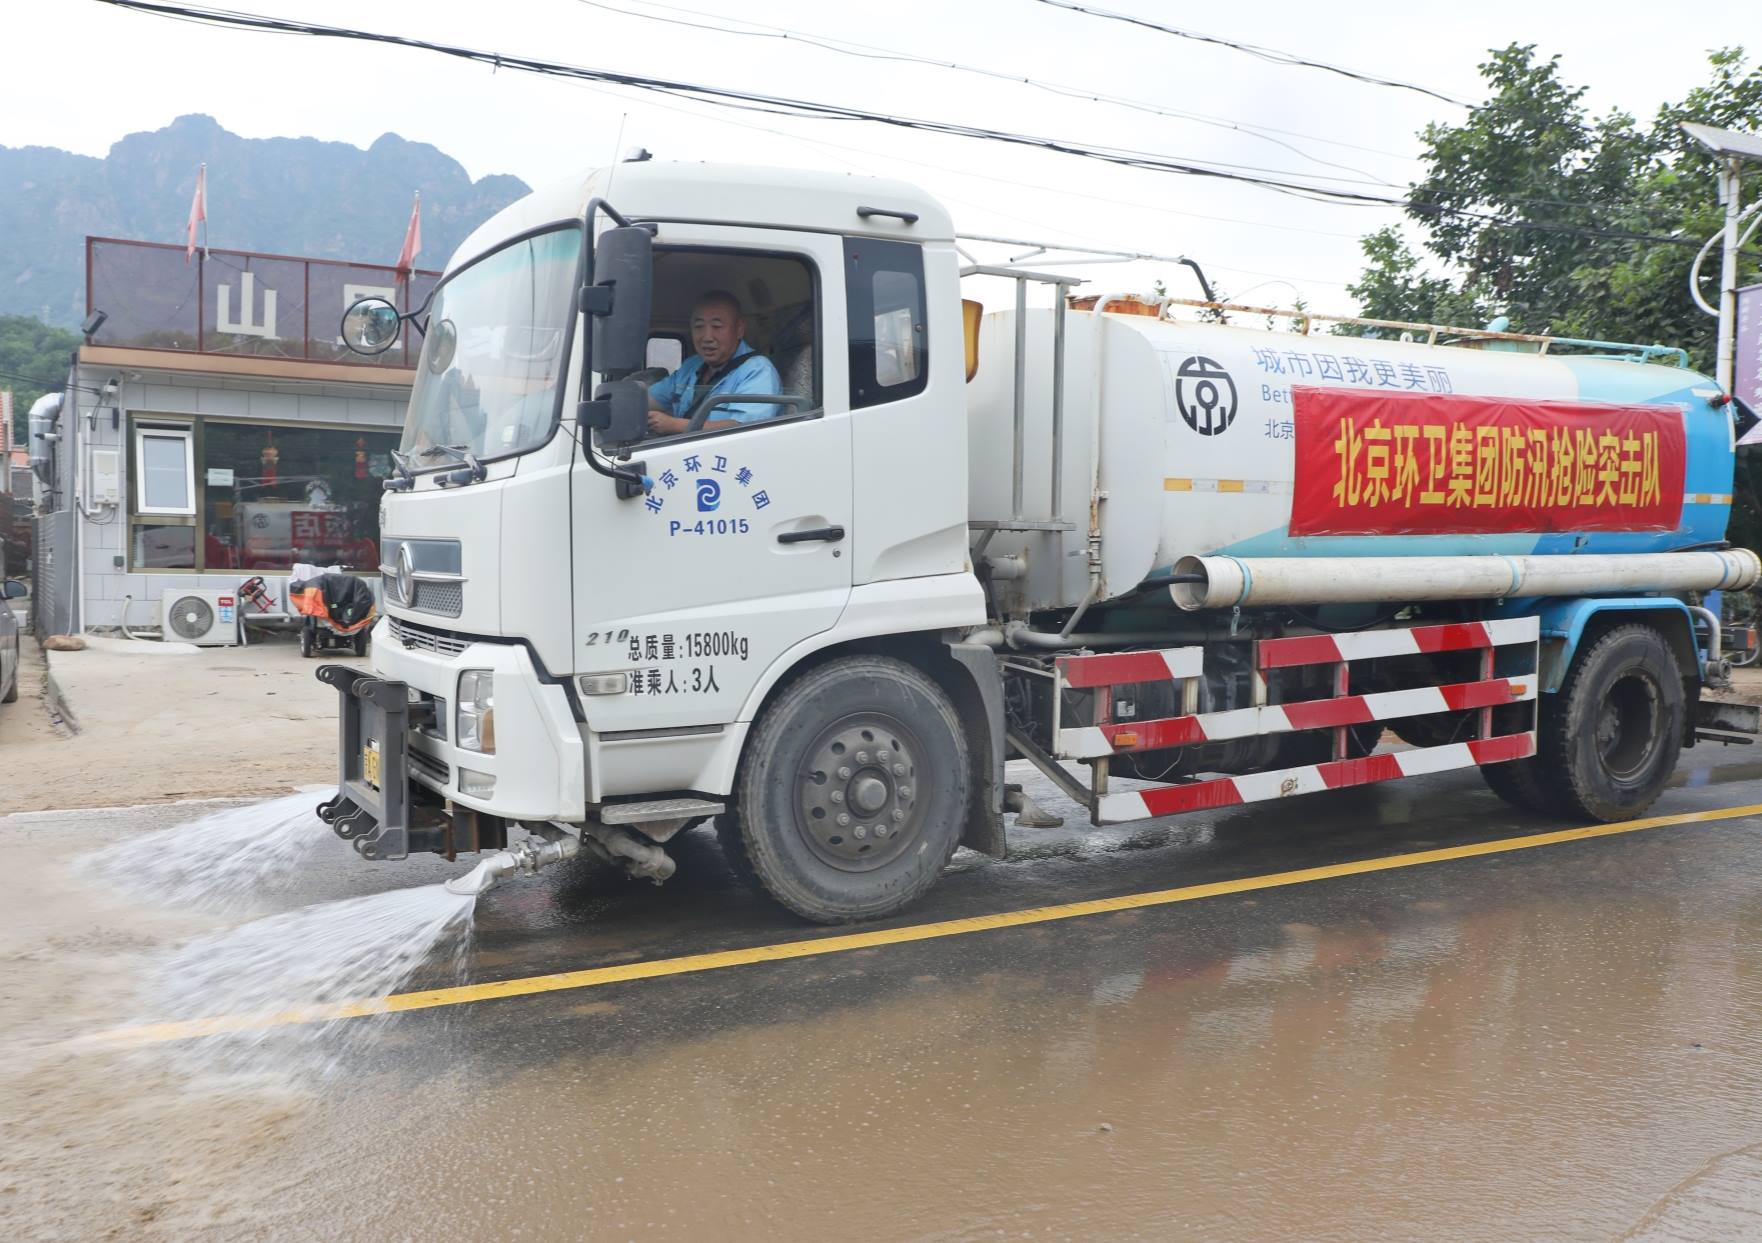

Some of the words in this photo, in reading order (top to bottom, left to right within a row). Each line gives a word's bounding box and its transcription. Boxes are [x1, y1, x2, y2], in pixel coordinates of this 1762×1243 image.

[1250, 346, 1453, 394] 城市因我更美丽
[644, 454, 771, 514] 北京环卫集团
[1332, 417, 1662, 509] 北京环卫集团防汛抢险突击队
[669, 518, 749, 537] P-41015
[585, 628, 631, 646] 210
